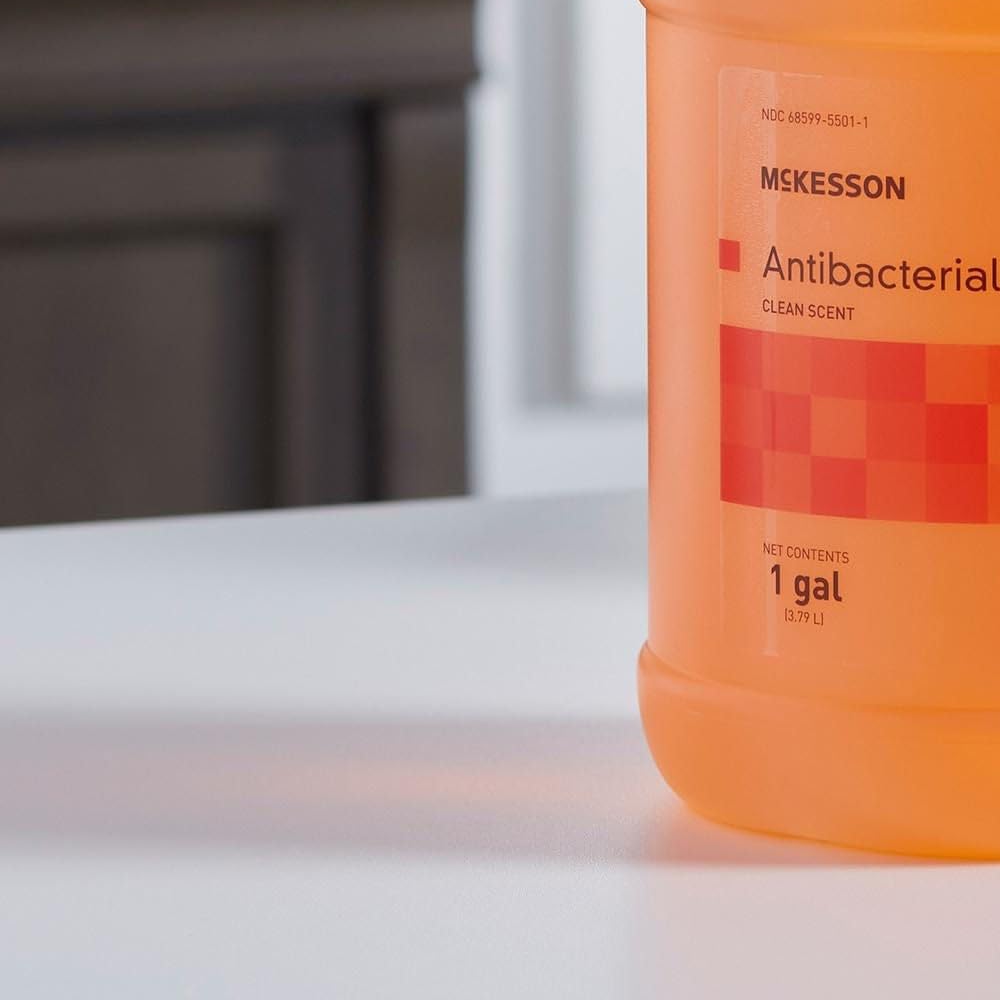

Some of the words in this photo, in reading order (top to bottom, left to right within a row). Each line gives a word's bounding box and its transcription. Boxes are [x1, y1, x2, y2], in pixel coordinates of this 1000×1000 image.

[761, 108, 785, 123] NDC
[788, 111, 869, 129] 68599-5501-1
[762, 245, 1000, 293] Antibacterial
[762, 299, 804, 317] CLEAN
[807, 303, 855, 321] SCENT
[762, 542, 784, 557] NET
[786, 545, 850, 564] CONTENTS
[771, 564, 781, 595] 1
[794, 571, 842, 606] gal
